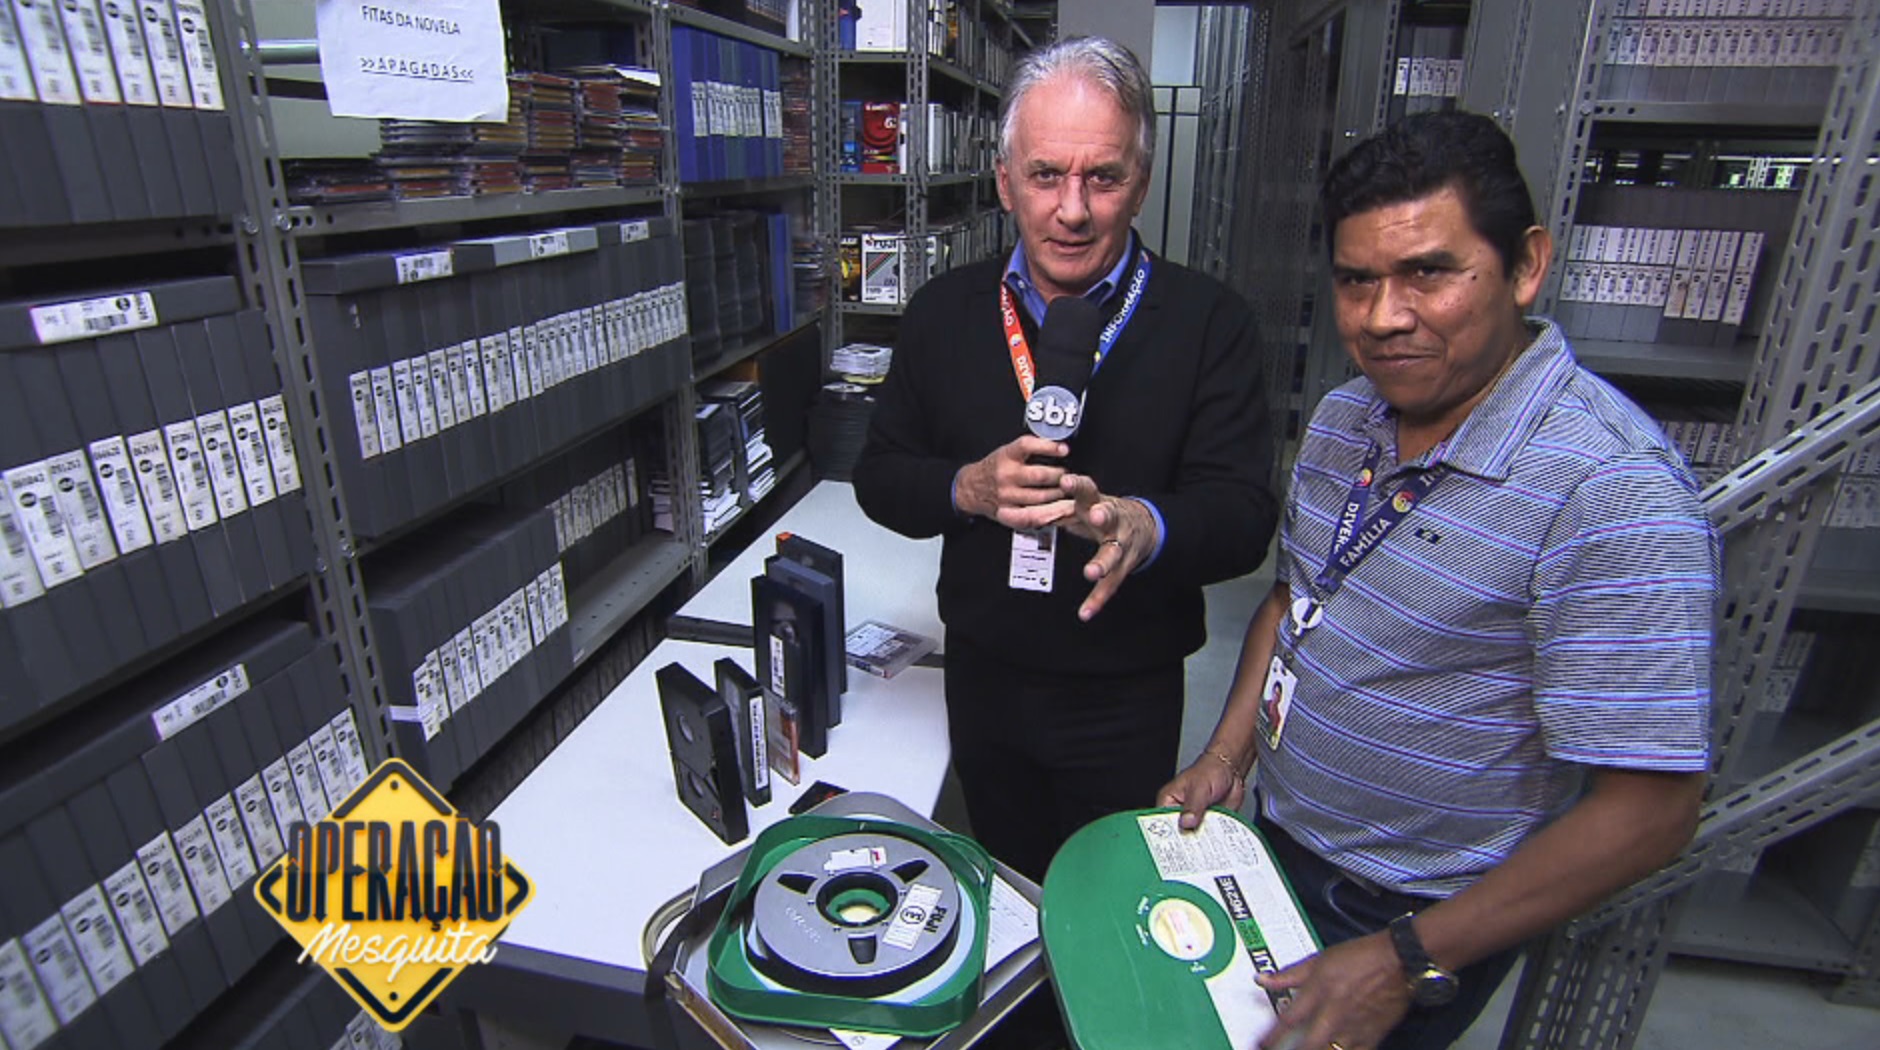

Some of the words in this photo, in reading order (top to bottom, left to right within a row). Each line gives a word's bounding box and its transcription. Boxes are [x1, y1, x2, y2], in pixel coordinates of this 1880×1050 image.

[361, 5, 393, 25] FITAS
[396, 12, 414, 28] DA
[415, 17, 461, 35] NOVELA
[1099, 269, 1146, 344] INFORMAÇÃO
[1016, 354, 1036, 394] DIVE
[1026, 395, 1078, 428] sbt
[1339, 517, 1393, 568] FAMÍLIA
[923, 904, 948, 934] FUJI
